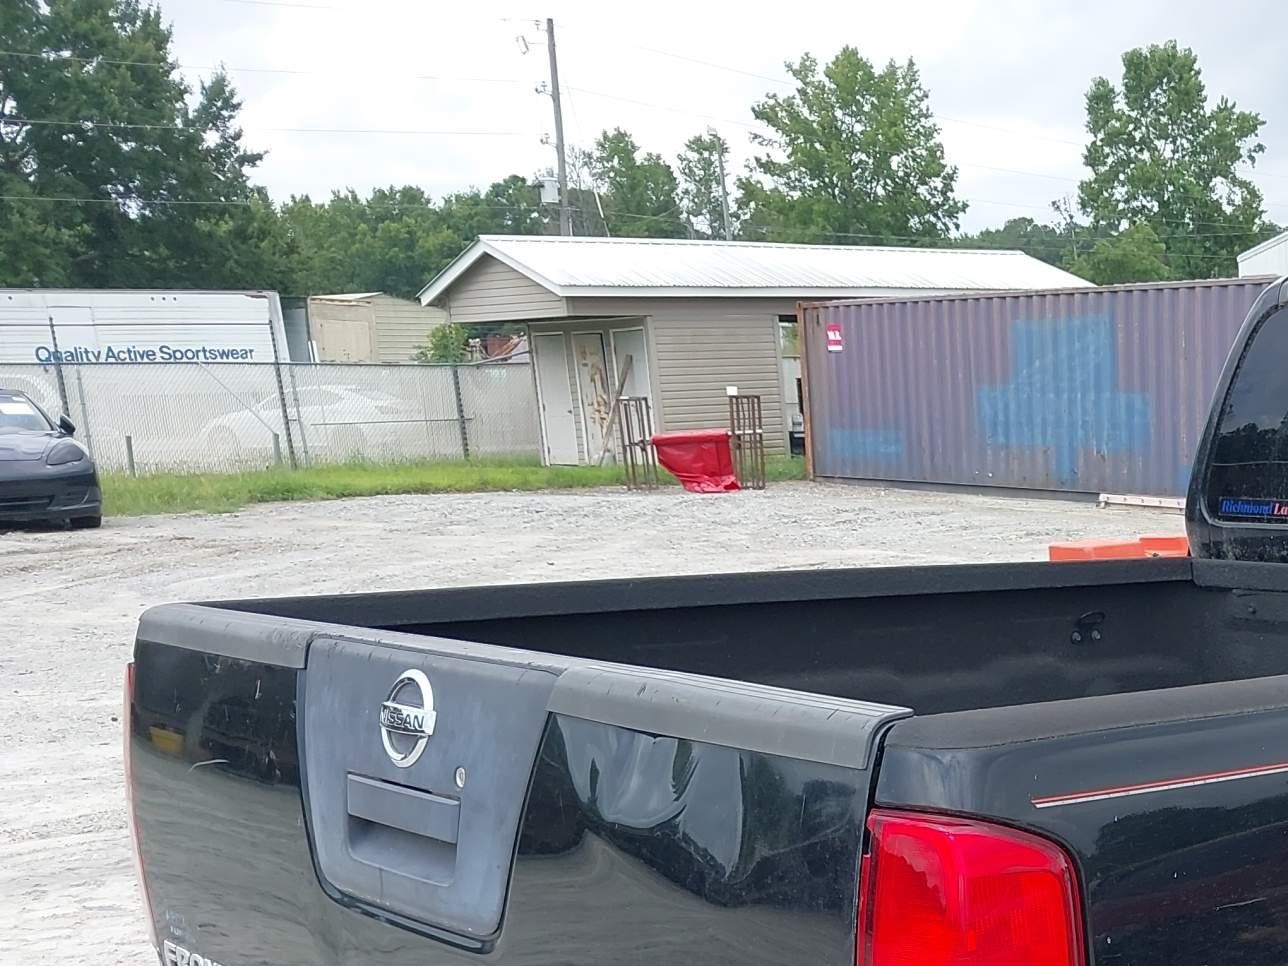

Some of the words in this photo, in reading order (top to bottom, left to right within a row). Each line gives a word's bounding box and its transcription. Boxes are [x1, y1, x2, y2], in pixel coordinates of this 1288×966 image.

[35, 346, 101, 363] Quality
[105, 346, 156, 362] Active
[159, 345, 254, 362] Sportswear
[1222, 500, 1272, 515] Richmond
[380, 706, 425, 730] NISSAN
